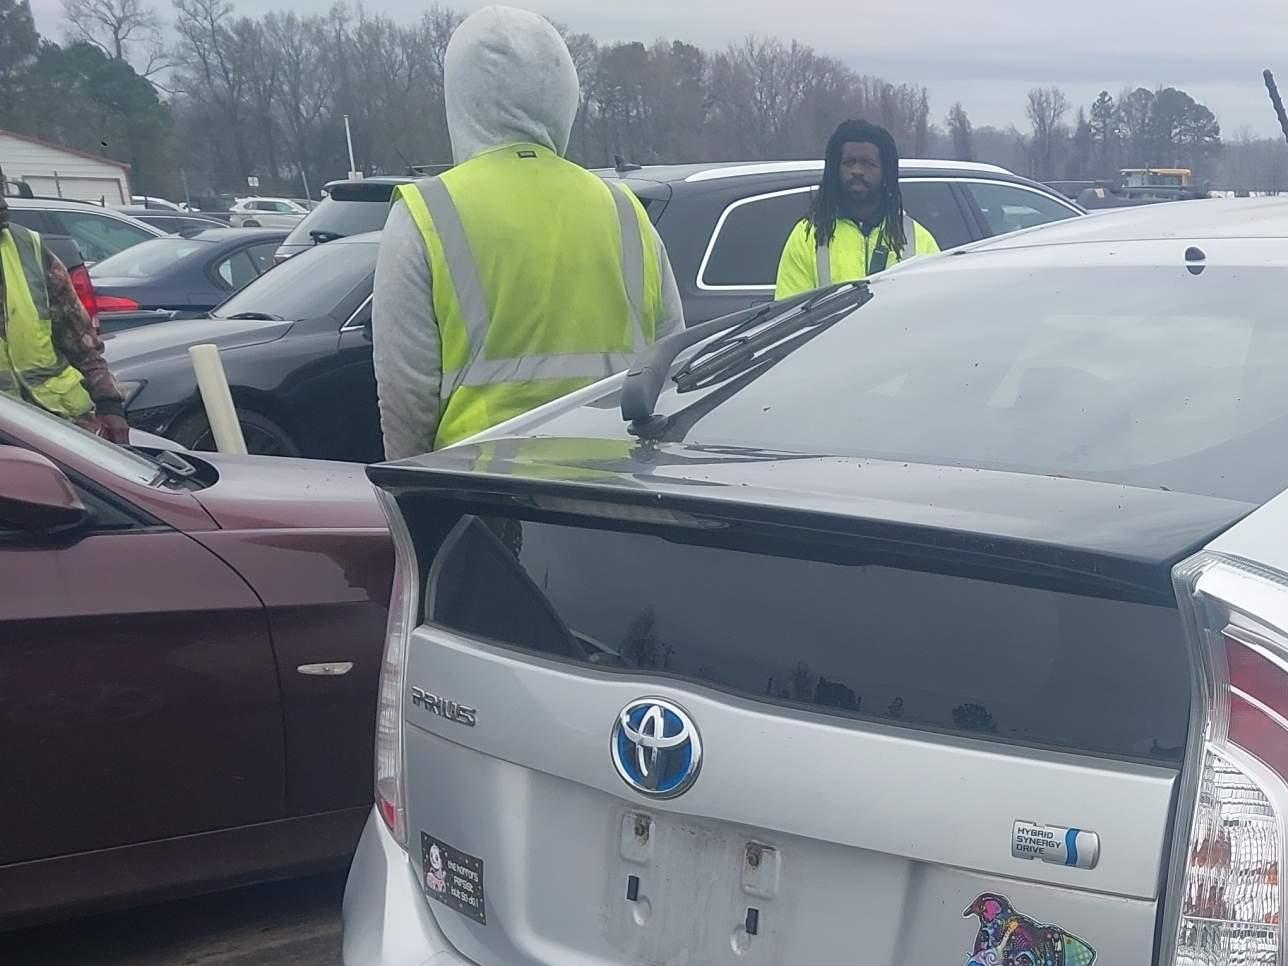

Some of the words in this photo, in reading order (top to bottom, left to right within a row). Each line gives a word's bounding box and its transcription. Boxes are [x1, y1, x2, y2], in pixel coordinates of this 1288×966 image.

[411, 685, 477, 727] PRIUS
[1017, 826, 1055, 840] HYBRID
[1016, 835, 1062, 849] SYNERGY
[1016, 844, 1046, 855] DRIVE
